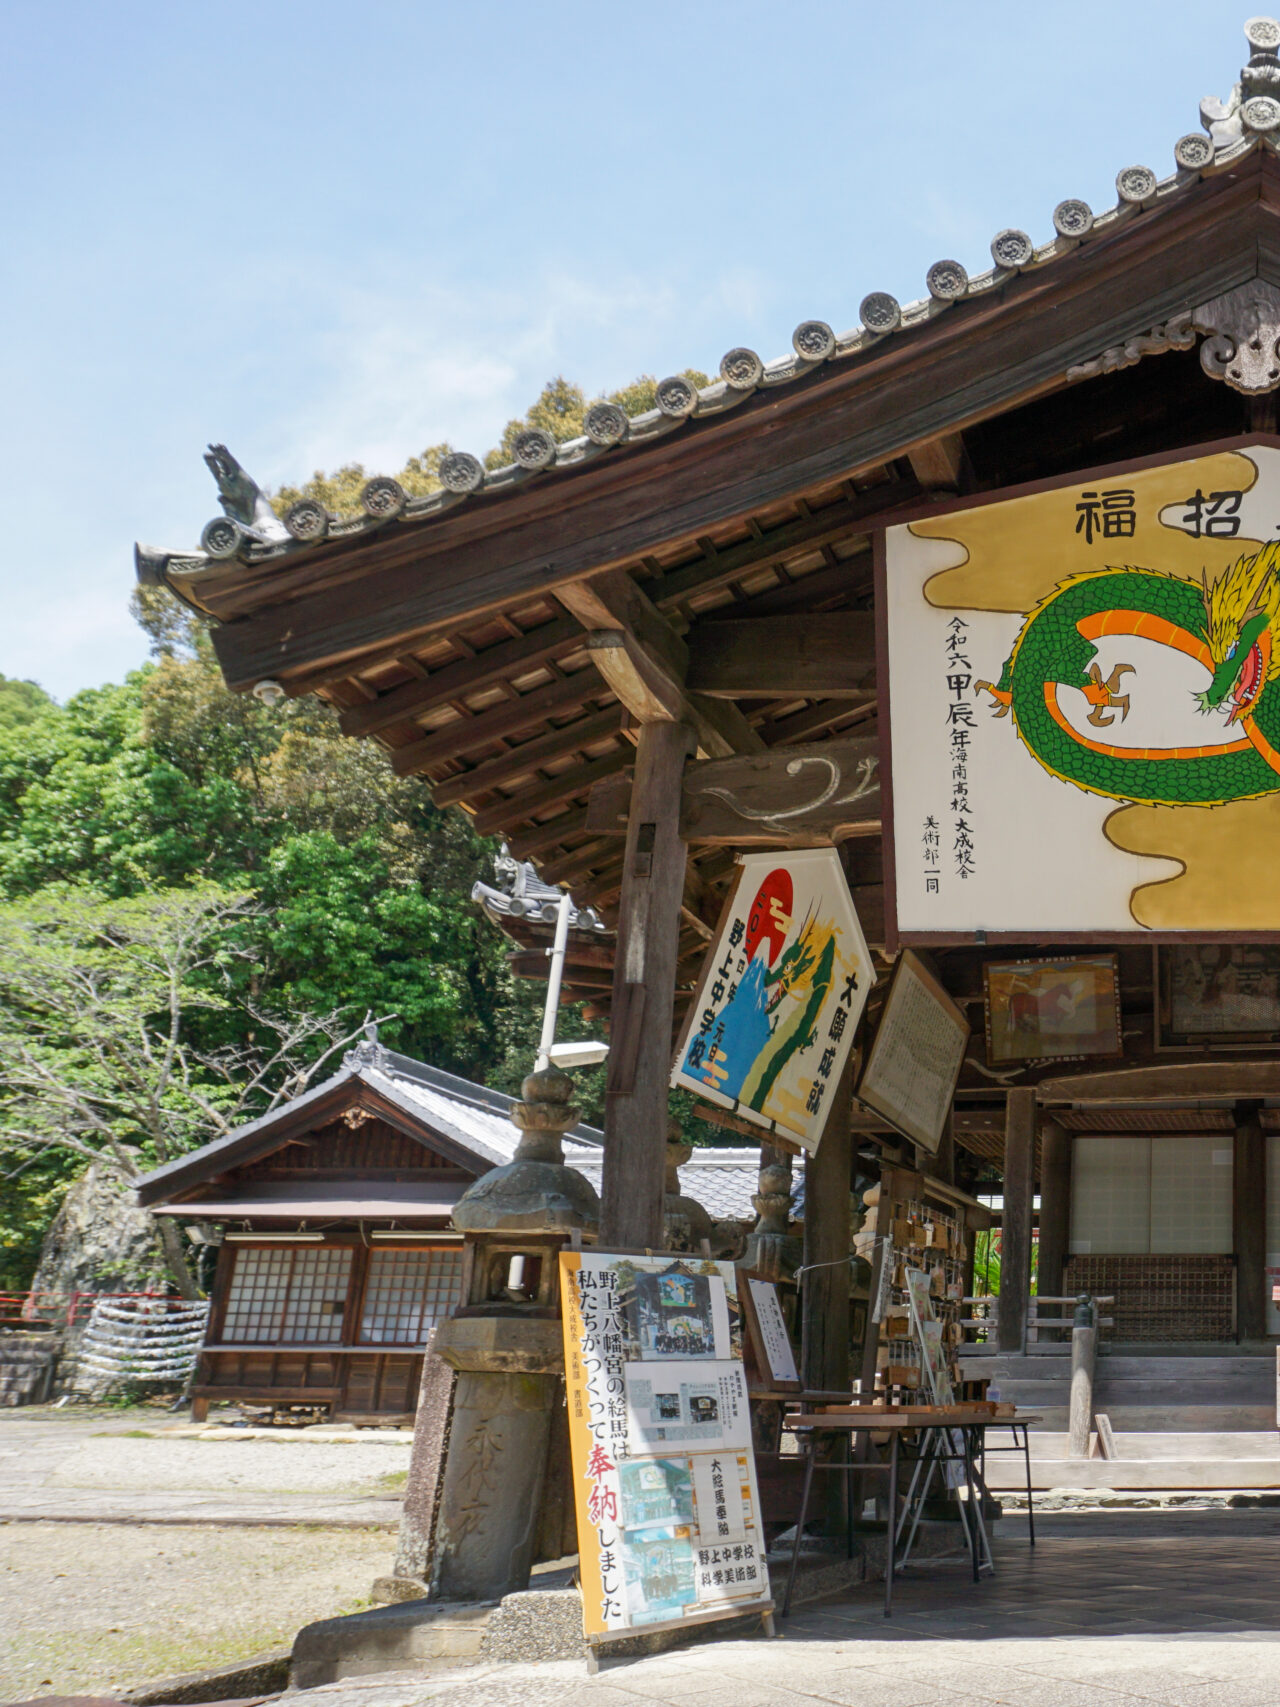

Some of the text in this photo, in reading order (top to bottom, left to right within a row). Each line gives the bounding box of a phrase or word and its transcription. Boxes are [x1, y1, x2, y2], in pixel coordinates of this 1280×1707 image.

[921, 815, 941, 894] 美術部一同
[599, 1271, 631, 1461] 野上八幡宮の絵馬は
[711, 1458, 730, 1537] 大絵馬奉納
[698, 1544, 754, 1566] 野上中学校
[701, 1565, 757, 1588] 科学美術部
